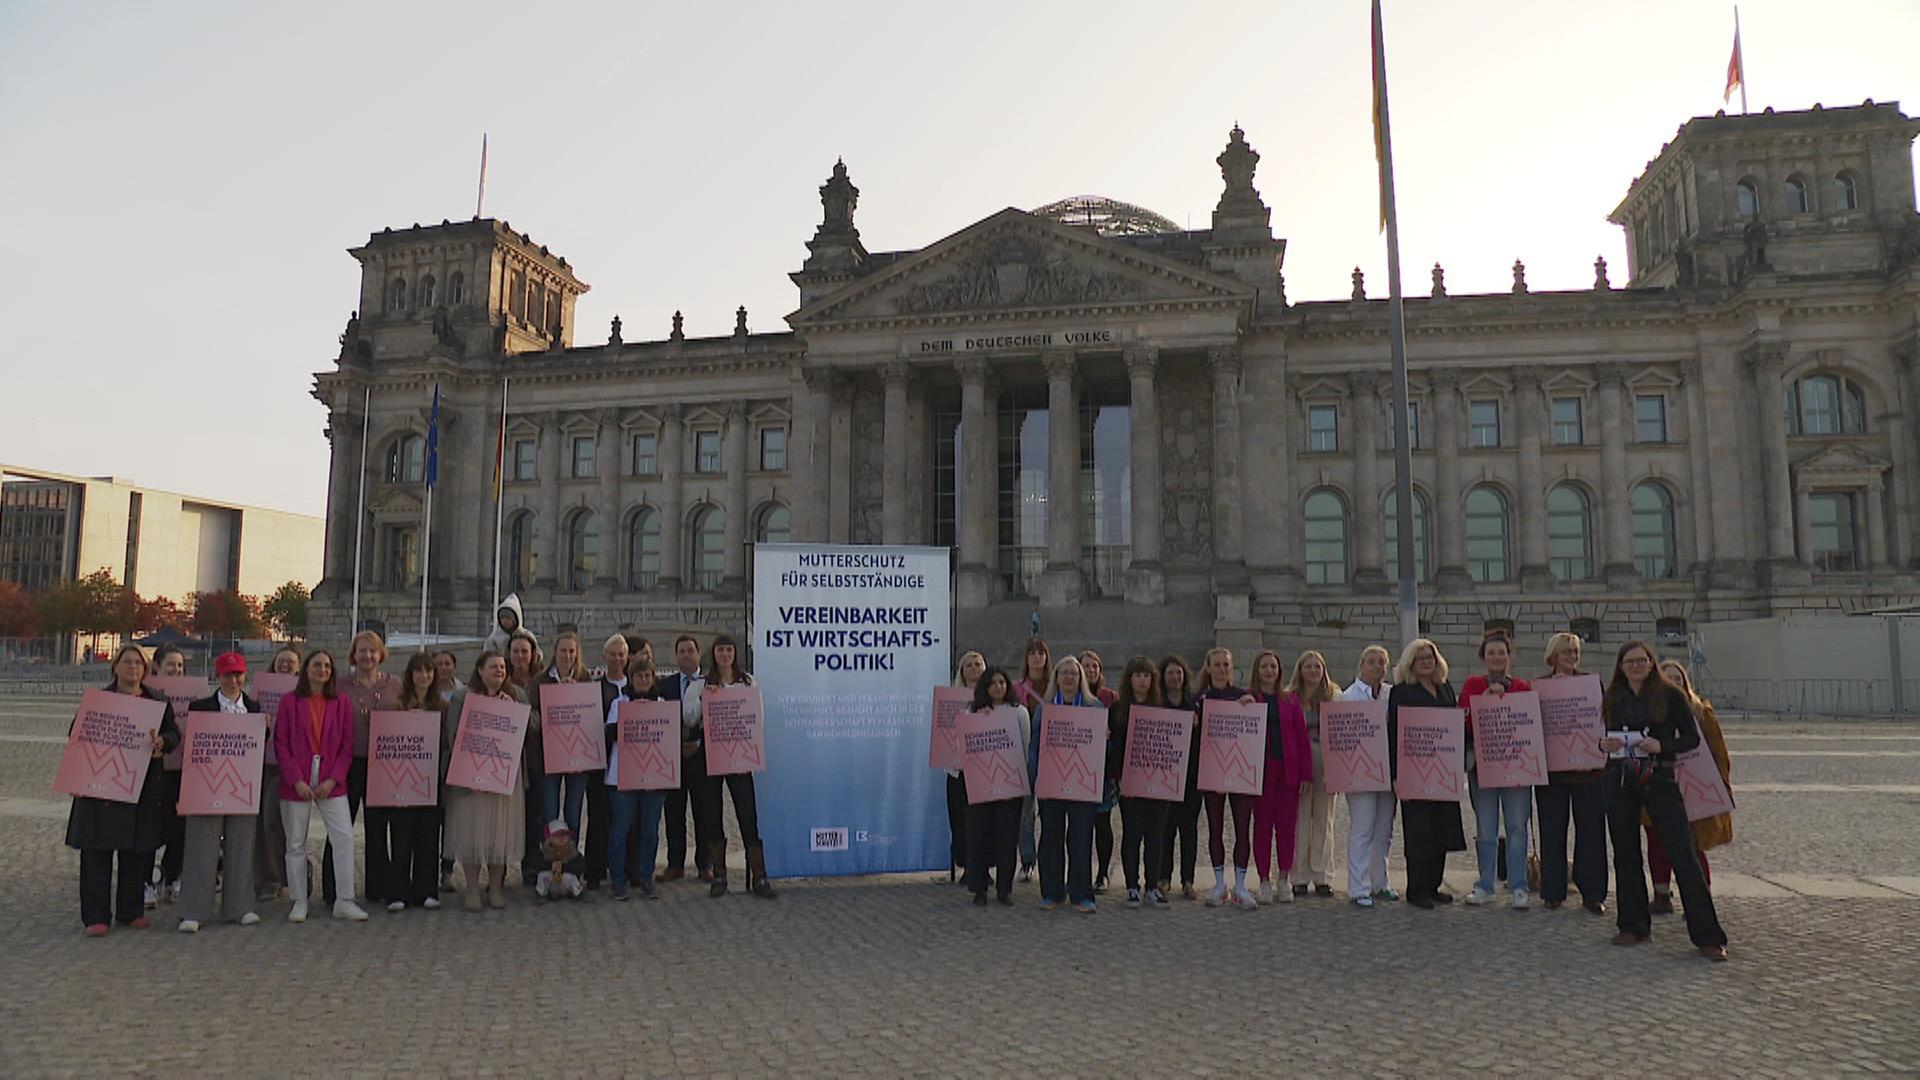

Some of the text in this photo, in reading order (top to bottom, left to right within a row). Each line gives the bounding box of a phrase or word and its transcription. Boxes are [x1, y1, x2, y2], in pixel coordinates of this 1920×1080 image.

[921, 330, 1110, 352] DEM DEUTSCHEN VOLKE
[799, 554, 905, 568] MUTTERSCHUTZ
[781, 570, 925, 588] FÜR SELBSTSTÄNDIGE
[779, 606, 928, 624] VEREINBARKEIT
[766, 630, 940, 648] IST WIRTSCHAFTS-
[814, 652, 895, 671] POLITIK!
[194, 732, 247, 740] SCHWANGER
[376, 735, 425, 743] ANGST VOR
[212, 740, 258, 749] PLÖTZLICH
[376, 744, 425, 752] ZAHLUNGS-
[192, 756, 213, 764] WEG.
